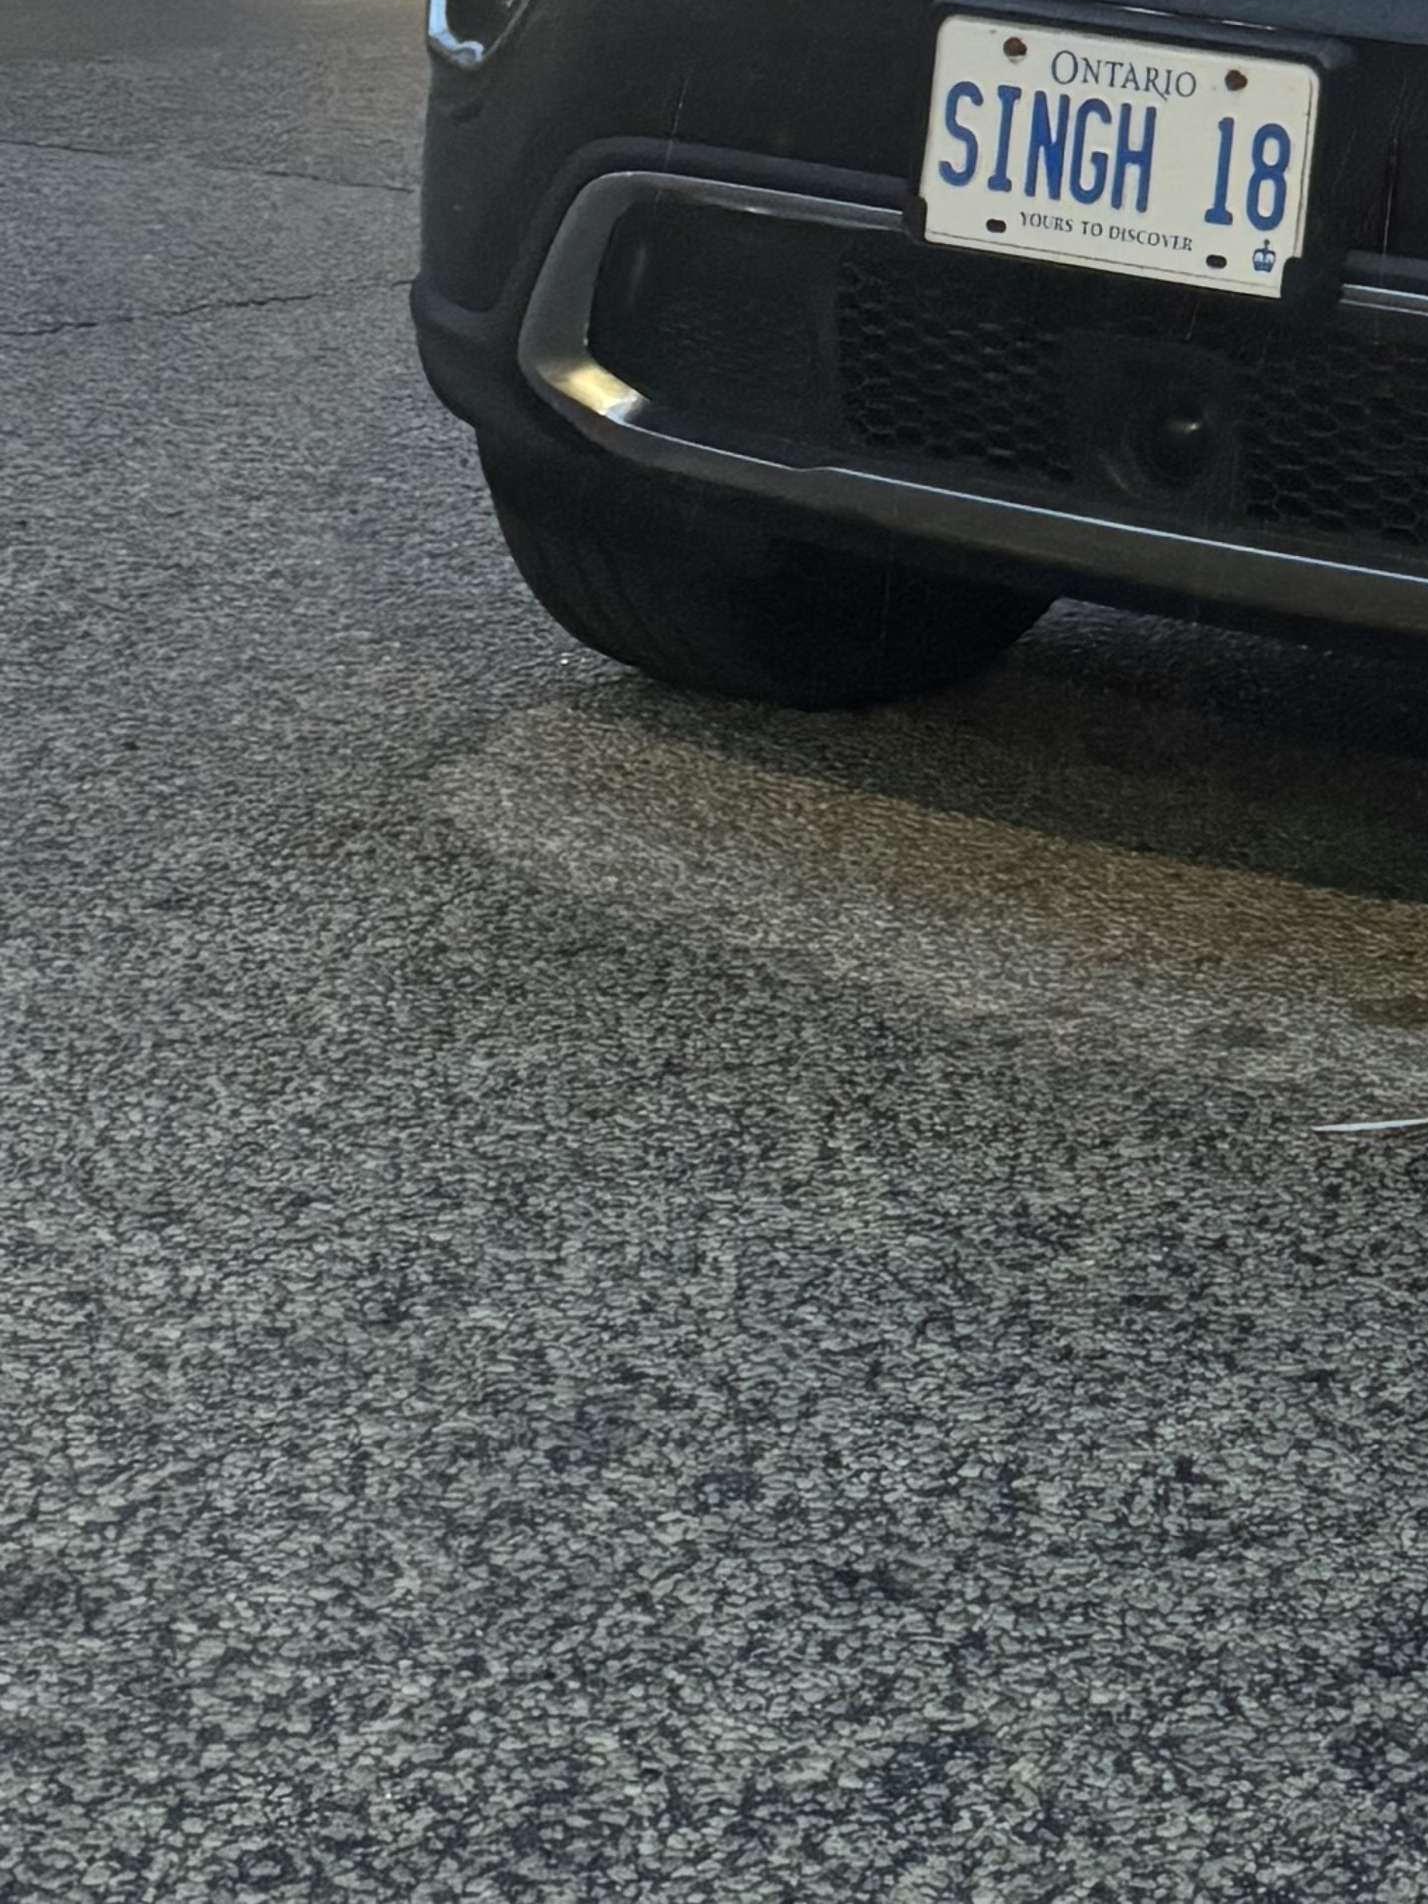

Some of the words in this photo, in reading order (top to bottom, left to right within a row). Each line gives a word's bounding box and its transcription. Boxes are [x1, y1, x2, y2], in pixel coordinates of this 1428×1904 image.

[1050, 49, 1198, 101] ONTARIO
[938, 80, 1157, 214] SINGH
[1203, 116, 1292, 232] 18
[1019, 210, 1074, 233] YOURS
[1080, 220, 1104, 239] TO
[1108, 225, 1194, 254] DISCOVER
